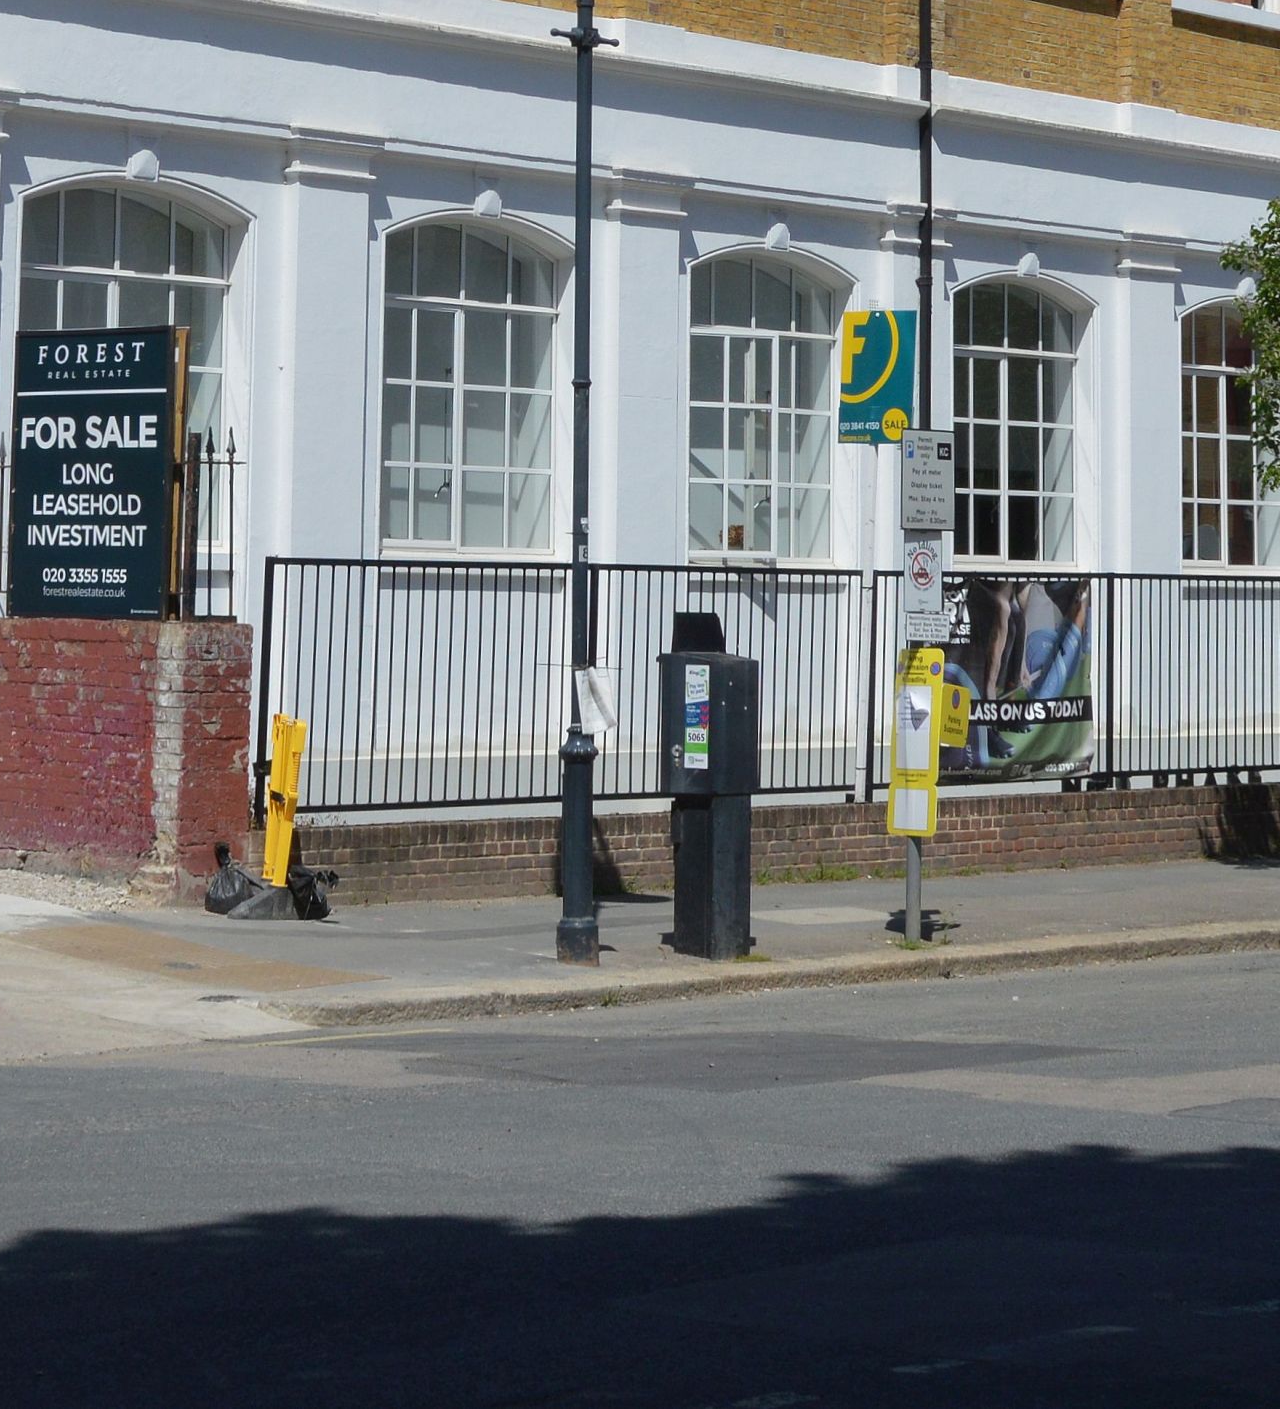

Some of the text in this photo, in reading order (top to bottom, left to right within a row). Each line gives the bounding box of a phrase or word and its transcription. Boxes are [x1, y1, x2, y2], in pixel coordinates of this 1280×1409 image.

[37, 342, 145, 365] FOREST
[47, 369, 131, 379] REAL ESTATE
[21, 415, 157, 449] FOR SALE
[885, 420, 906, 429] SALE
[939, 447, 949, 457] KC
[62, 463, 114, 485] LONG
[33, 494, 141, 515] LEASEHOLD
[27, 525, 147, 547] INVESTMENT
[907, 546, 918, 559] No
[42, 568, 127, 583] 020 3355 1555
[42, 585, 126, 598] forestrealestate.co.uk
[968, 699, 1084, 721] LASS ON US TODAY
[688, 733, 705, 742] 5065
